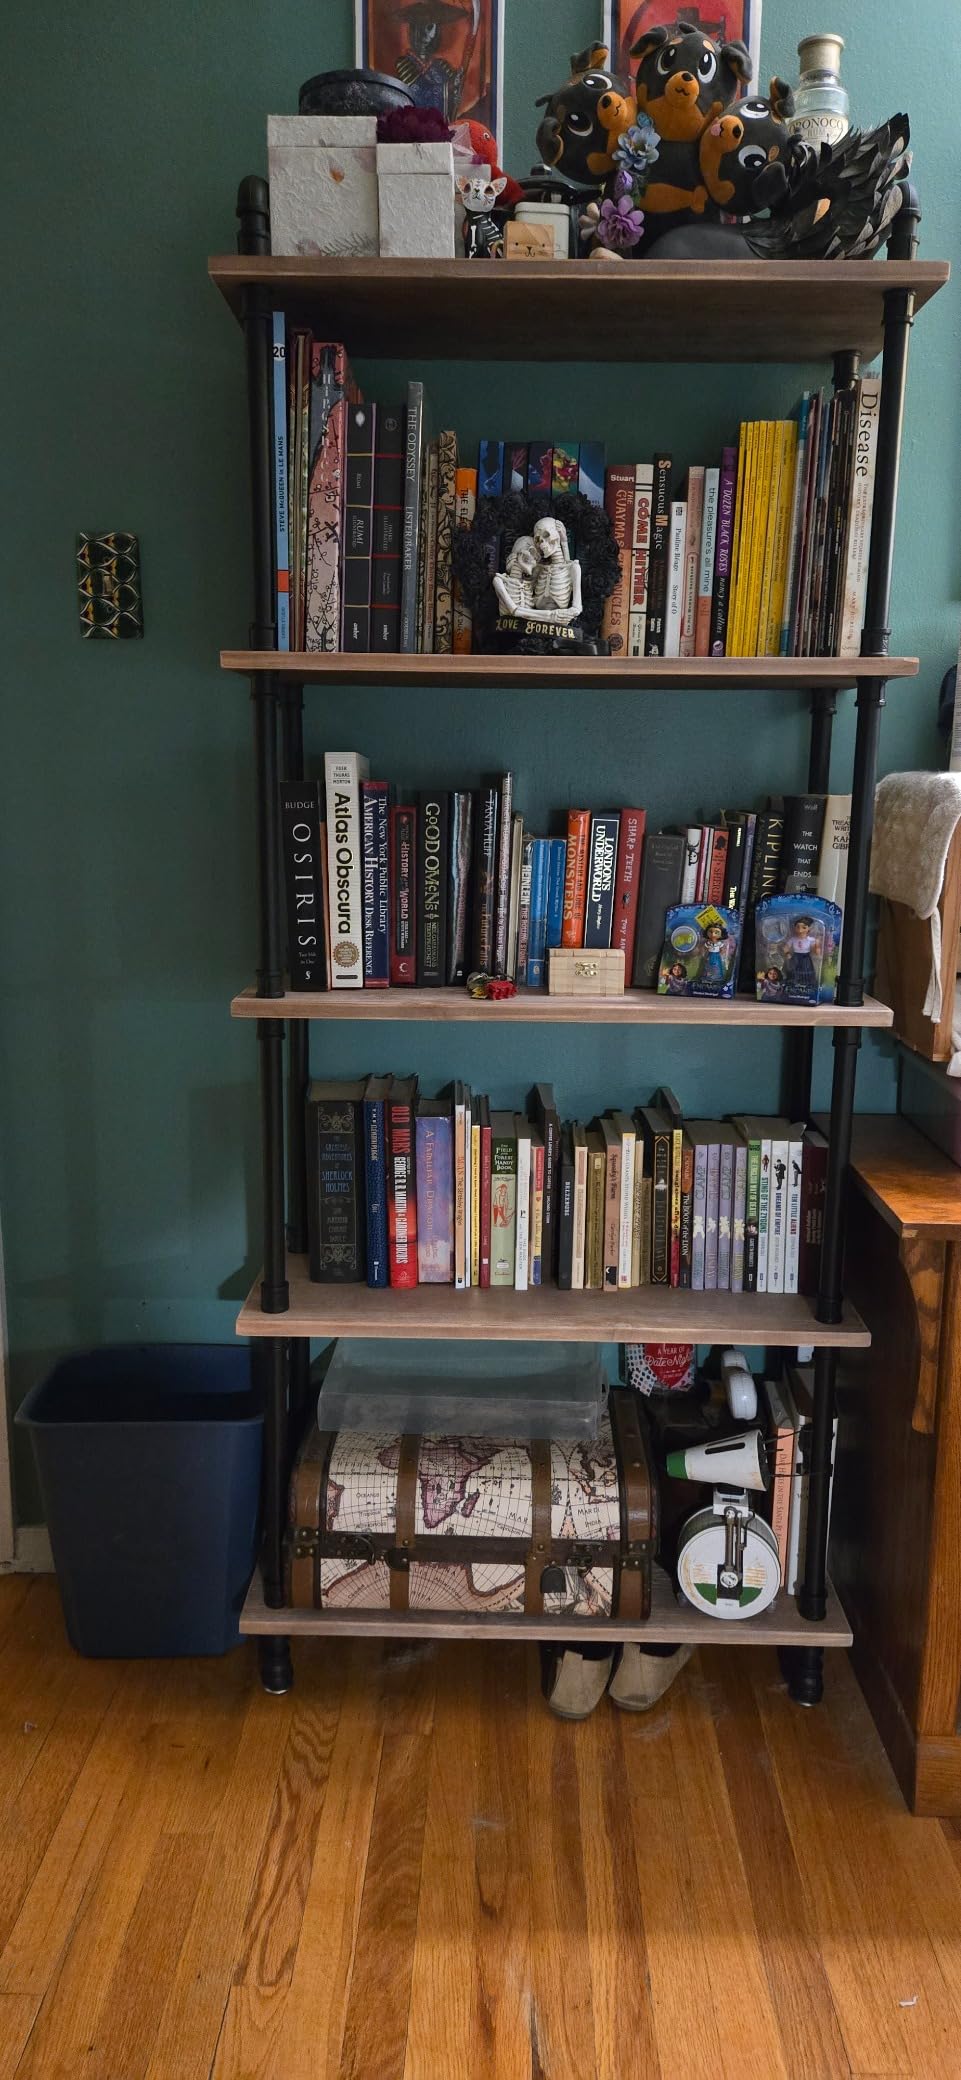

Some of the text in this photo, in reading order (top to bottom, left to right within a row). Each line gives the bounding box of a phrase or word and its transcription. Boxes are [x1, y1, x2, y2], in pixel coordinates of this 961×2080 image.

[406, 406, 417, 482] THE ODYSSEY
[856, 392, 878, 477] Disease
[278, 457, 284, 467] LE
[626, 490, 634, 505] THE
[657, 460, 671, 514] Sensuous
[707, 487, 716, 503] the
[722, 489, 733, 515] DOZEN
[356, 519, 364, 544] RUMI
[404, 506, 414, 570] LISTER/BAKER
[654, 514, 669, 550] Magic
[674, 528, 682, 552] Pauline
[705, 506, 715, 555] pleasure's
[720, 519, 731, 545] BLACK
[610, 490, 626, 626] GUAYMAS CNICLES
[633, 498, 649, 605] COME HITHER
[704, 557, 712, 568] all
[719, 548, 729, 572] ROSES
[671, 584, 680, 601] Story
[703, 570, 712, 592] mine
[495, 618, 575, 639] LOVE FOREVER
[716, 608, 725, 635] collins
[285, 801, 315, 809] BUDGE
[483, 799, 494, 857] TANYA HUFF
[623, 818, 638, 882] SHARP TEETH
[793, 843, 818, 851] WATCH
[334, 792, 353, 933] Atlas Obscura
[377, 796, 387, 934] The New York Public Library
[577, 849, 585, 876] MYSTERY
[592, 825, 605, 902] UNDERWORLD
[601, 837, 615, 891] LONDON'S
[793, 870, 812, 878] ENDS
[292, 823, 317, 946] OSIRIS
[364, 795, 379, 975] AMERICAN HISTORY DESK REFERENCE
[520, 864, 532, 905] HEINLEIN
[563, 834, 577, 920] MONSTERS
[711, 867, 721, 902] SHERLO
[400, 889, 409, 919] WORLD
[729, 886, 737, 898] THE
[520, 919, 528, 943] ROLLING
[519, 944, 527, 967] STONES
[391, 1106, 410, 1154] OLD MARS
[425, 1130, 434, 1138] A
[394, 1156, 407, 1178] GEORGE
[426, 1142, 434, 1185] FAMILIAR
[751, 1155, 759, 1164] THE
[321, 1171, 353, 1181] SHERLOCK
[325, 1182, 350, 1193] HOLMES
[750, 1184, 758, 1194] WAY
[760, 1193, 768, 1201] OF
[395, 1190, 407, 1213] MARTIN
[749, 1201, 757, 1217] DEATH
[760, 1201, 768, 1212] THE
[682, 1205, 690, 1224] BOOK
[760, 1212, 768, 1233] ZYGONS
[395, 1217, 407, 1243] GARDNER
[396, 1243, 408, 1264] DOZOIS
[644, 1355, 667, 1367] Date
[775, 1506, 784, 1524] SANTA
